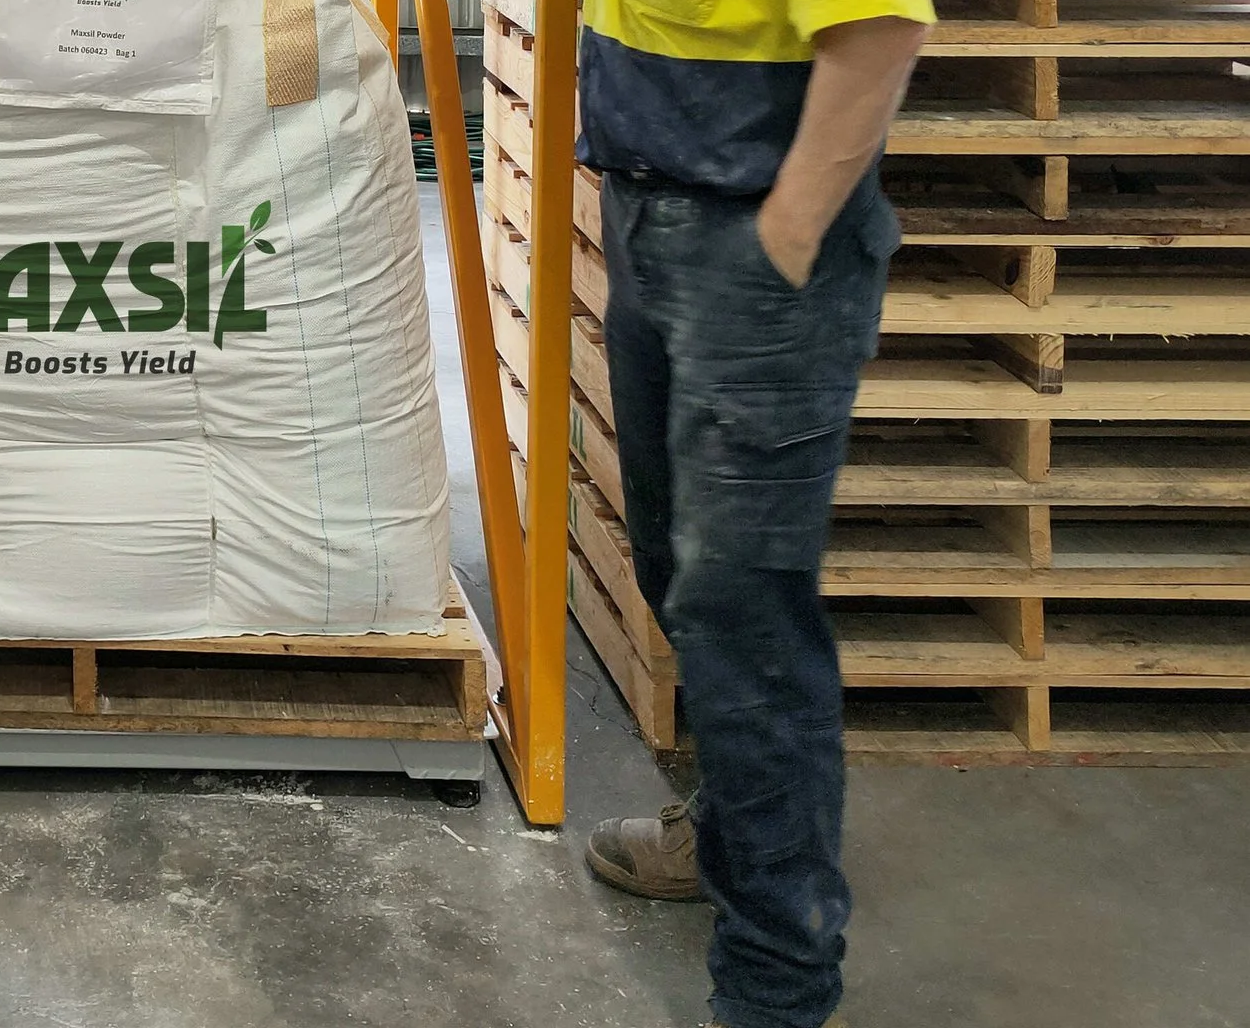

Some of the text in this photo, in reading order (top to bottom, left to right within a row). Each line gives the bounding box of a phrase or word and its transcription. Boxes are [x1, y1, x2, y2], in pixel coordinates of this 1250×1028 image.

[103, 0, 122, 7] Yield
[70, 29, 126, 40] Maxsil Powder
[58, 45, 136, 59] Batch 060423 Bag 1
[4, 350, 197, 375] Boosts Yield
